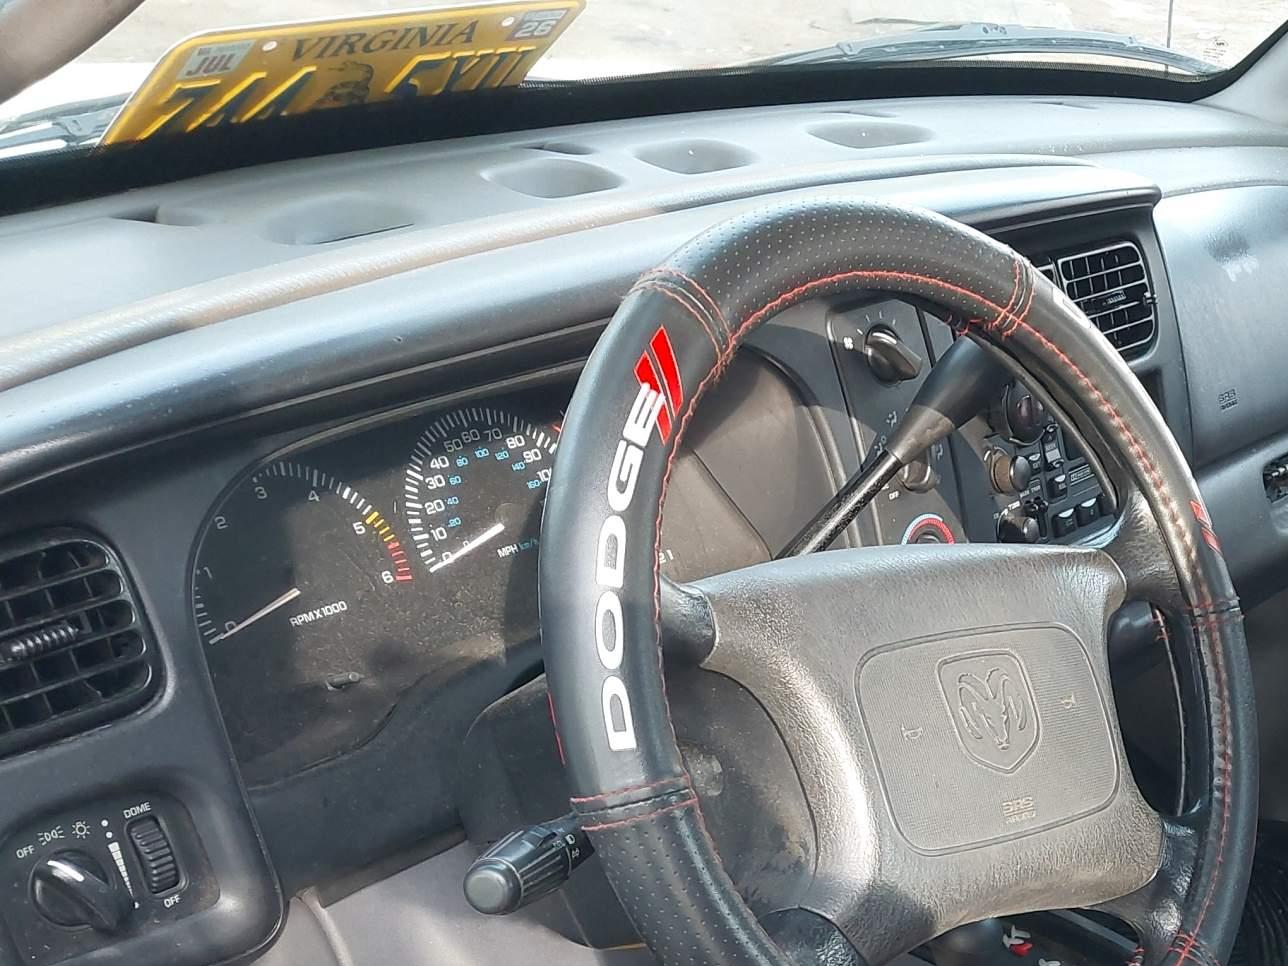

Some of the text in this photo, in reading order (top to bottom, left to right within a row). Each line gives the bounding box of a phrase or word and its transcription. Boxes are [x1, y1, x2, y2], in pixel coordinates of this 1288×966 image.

[514, 20, 556, 38] 26
[292, 20, 479, 62] VIRGINIA
[185, 53, 236, 76] JUL
[461, 429, 480, 443] 60
[483, 427, 503, 441] 70
[444, 439, 463, 452] 50
[505, 435, 525, 449] 80
[430, 455, 449, 470] 40
[523, 449, 542, 463] 90
[425, 474, 446, 489] 30
[536, 468, 552, 483] 10
[254, 486, 268, 500] 3
[308, 490, 320, 503] 4
[424, 499, 445, 515] 20
[214, 516, 229, 530] 2
[352, 521, 366, 535] 5
[430, 527, 447, 541] 10
[496, 544, 519, 558] MPH
[595, 382, 666, 752] DODGE
[381, 570, 394, 584] 6
[123, 802, 152, 819] DOME
[16, 845, 35, 859] OFF
[163, 894, 181, 909] OFF
